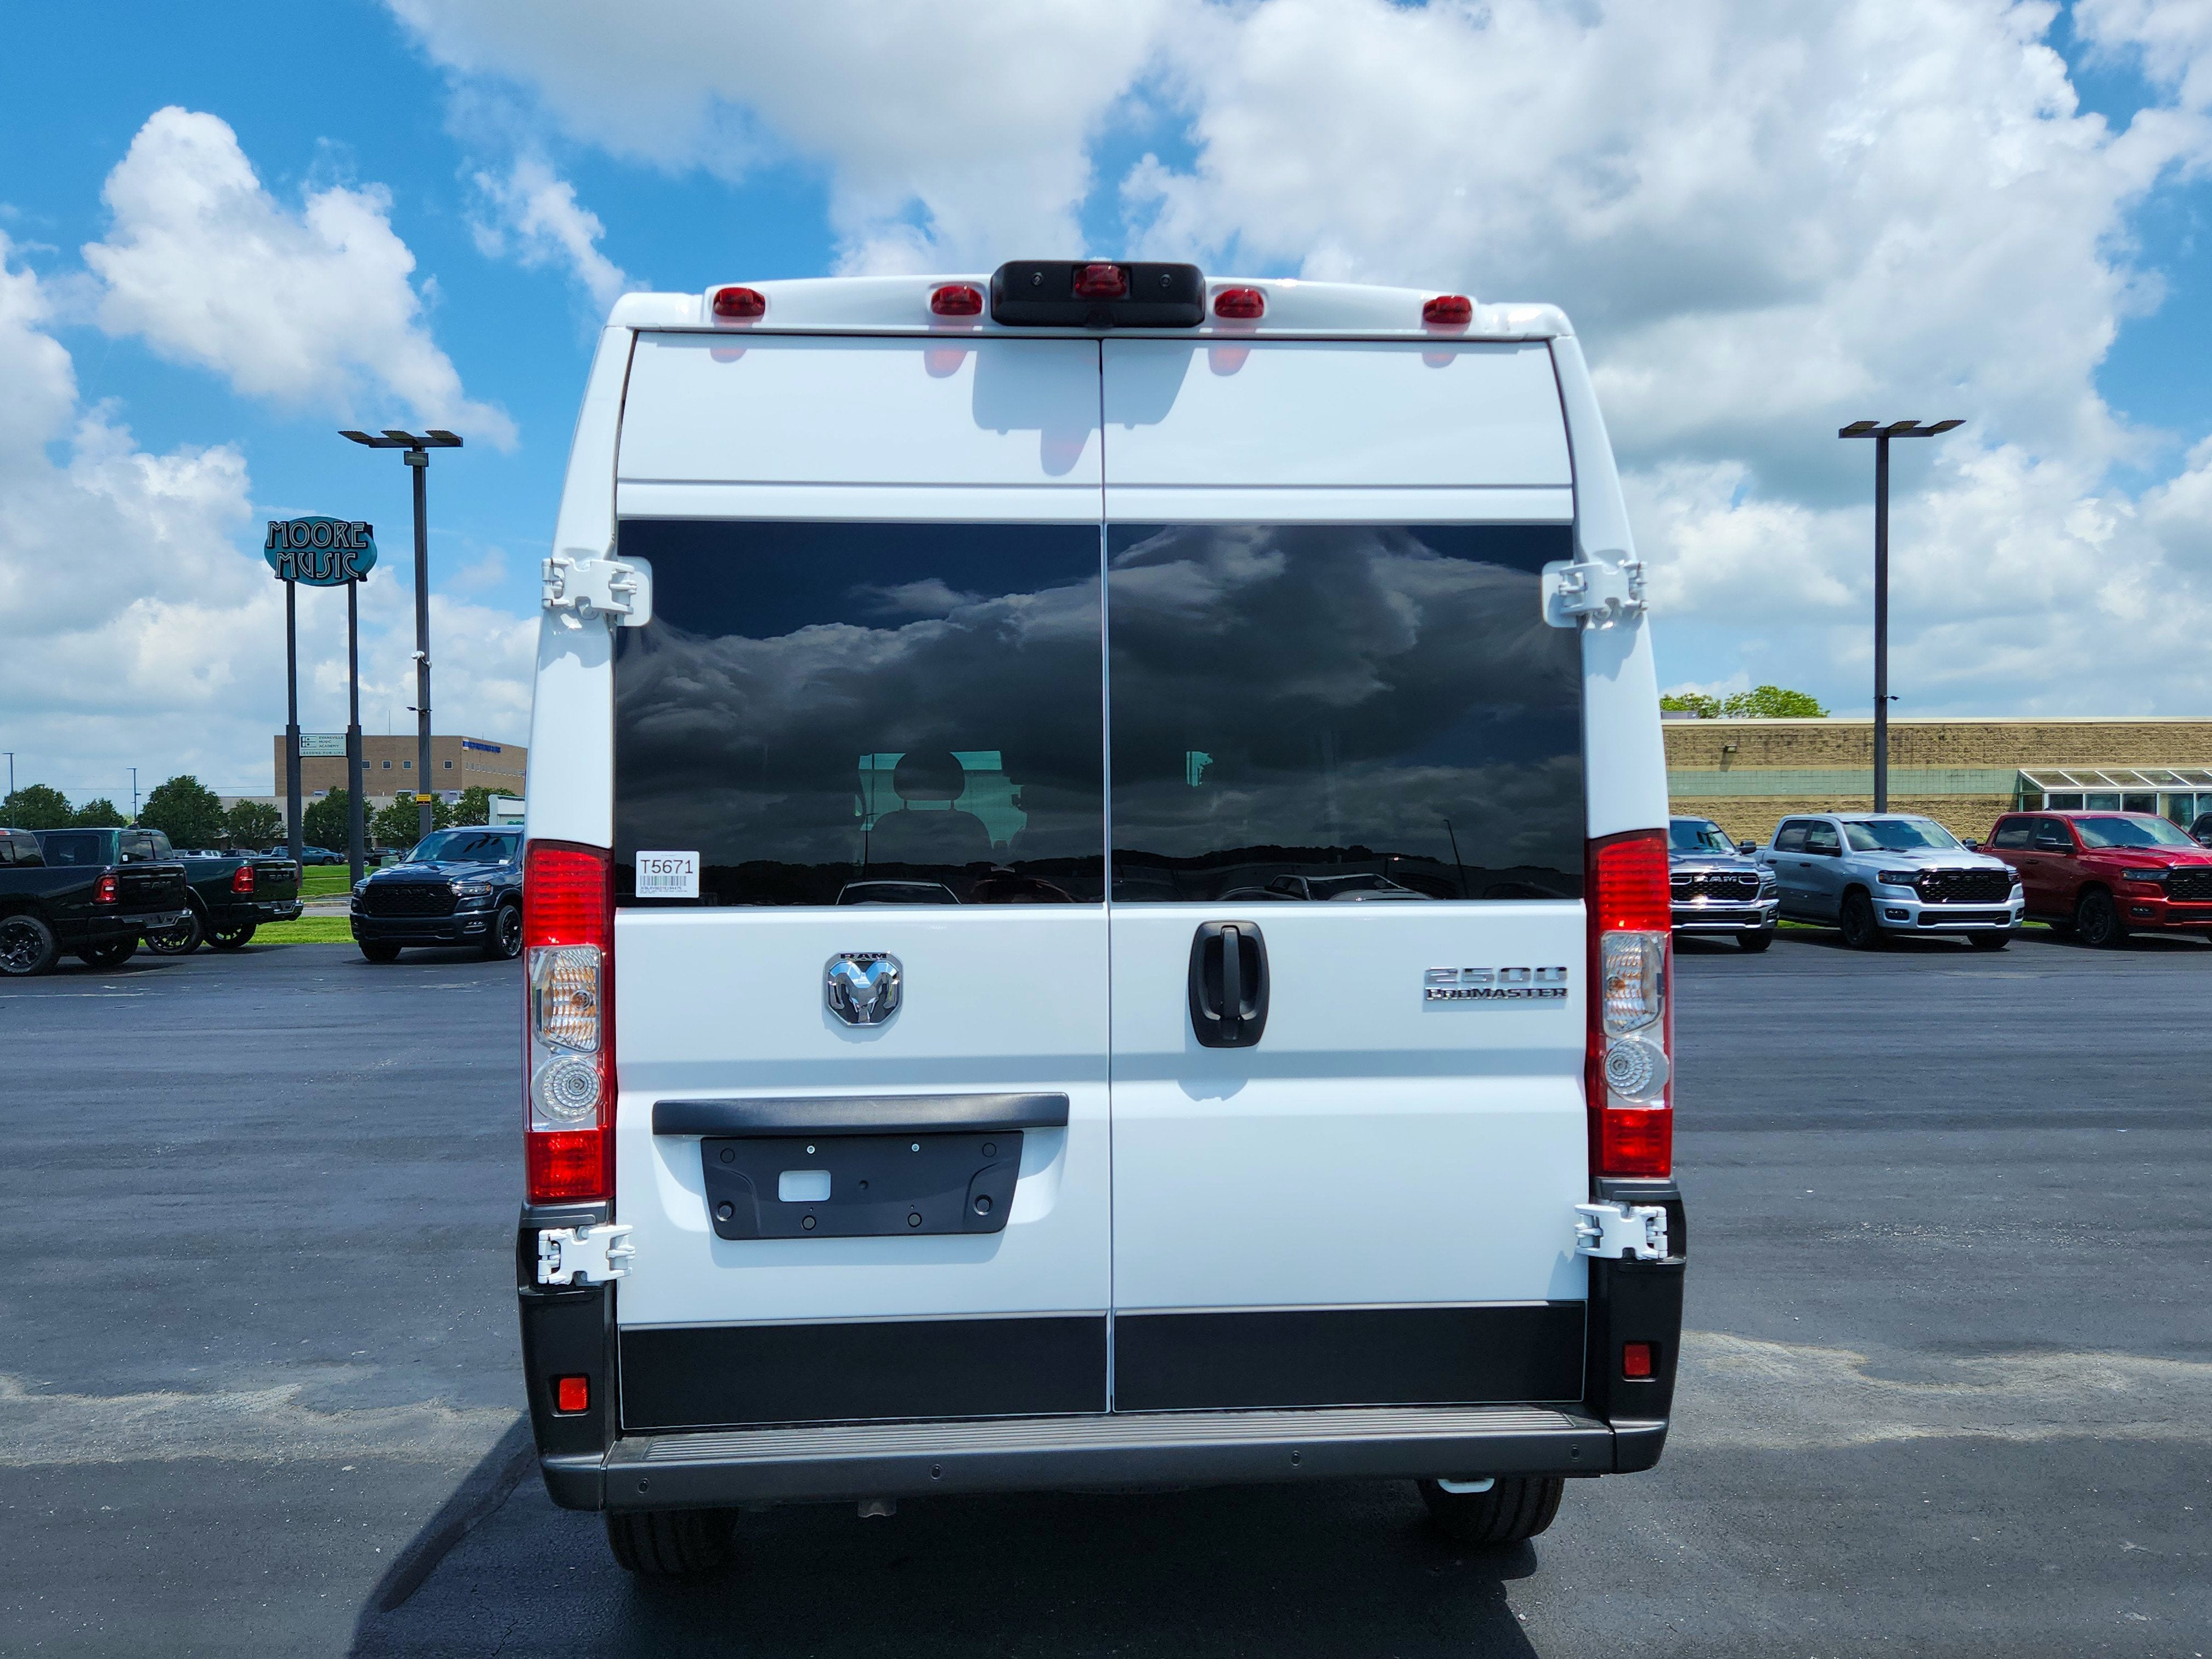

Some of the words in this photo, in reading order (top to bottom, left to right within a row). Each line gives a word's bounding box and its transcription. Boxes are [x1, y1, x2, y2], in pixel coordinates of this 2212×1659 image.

[267, 522, 366, 548] MOORE
[275, 552, 358, 578] MUSIC
[640, 859, 693, 874] T5671
[1425, 967, 1568, 983] 2500
[1425, 987, 1568, 1000] PROMASTER
